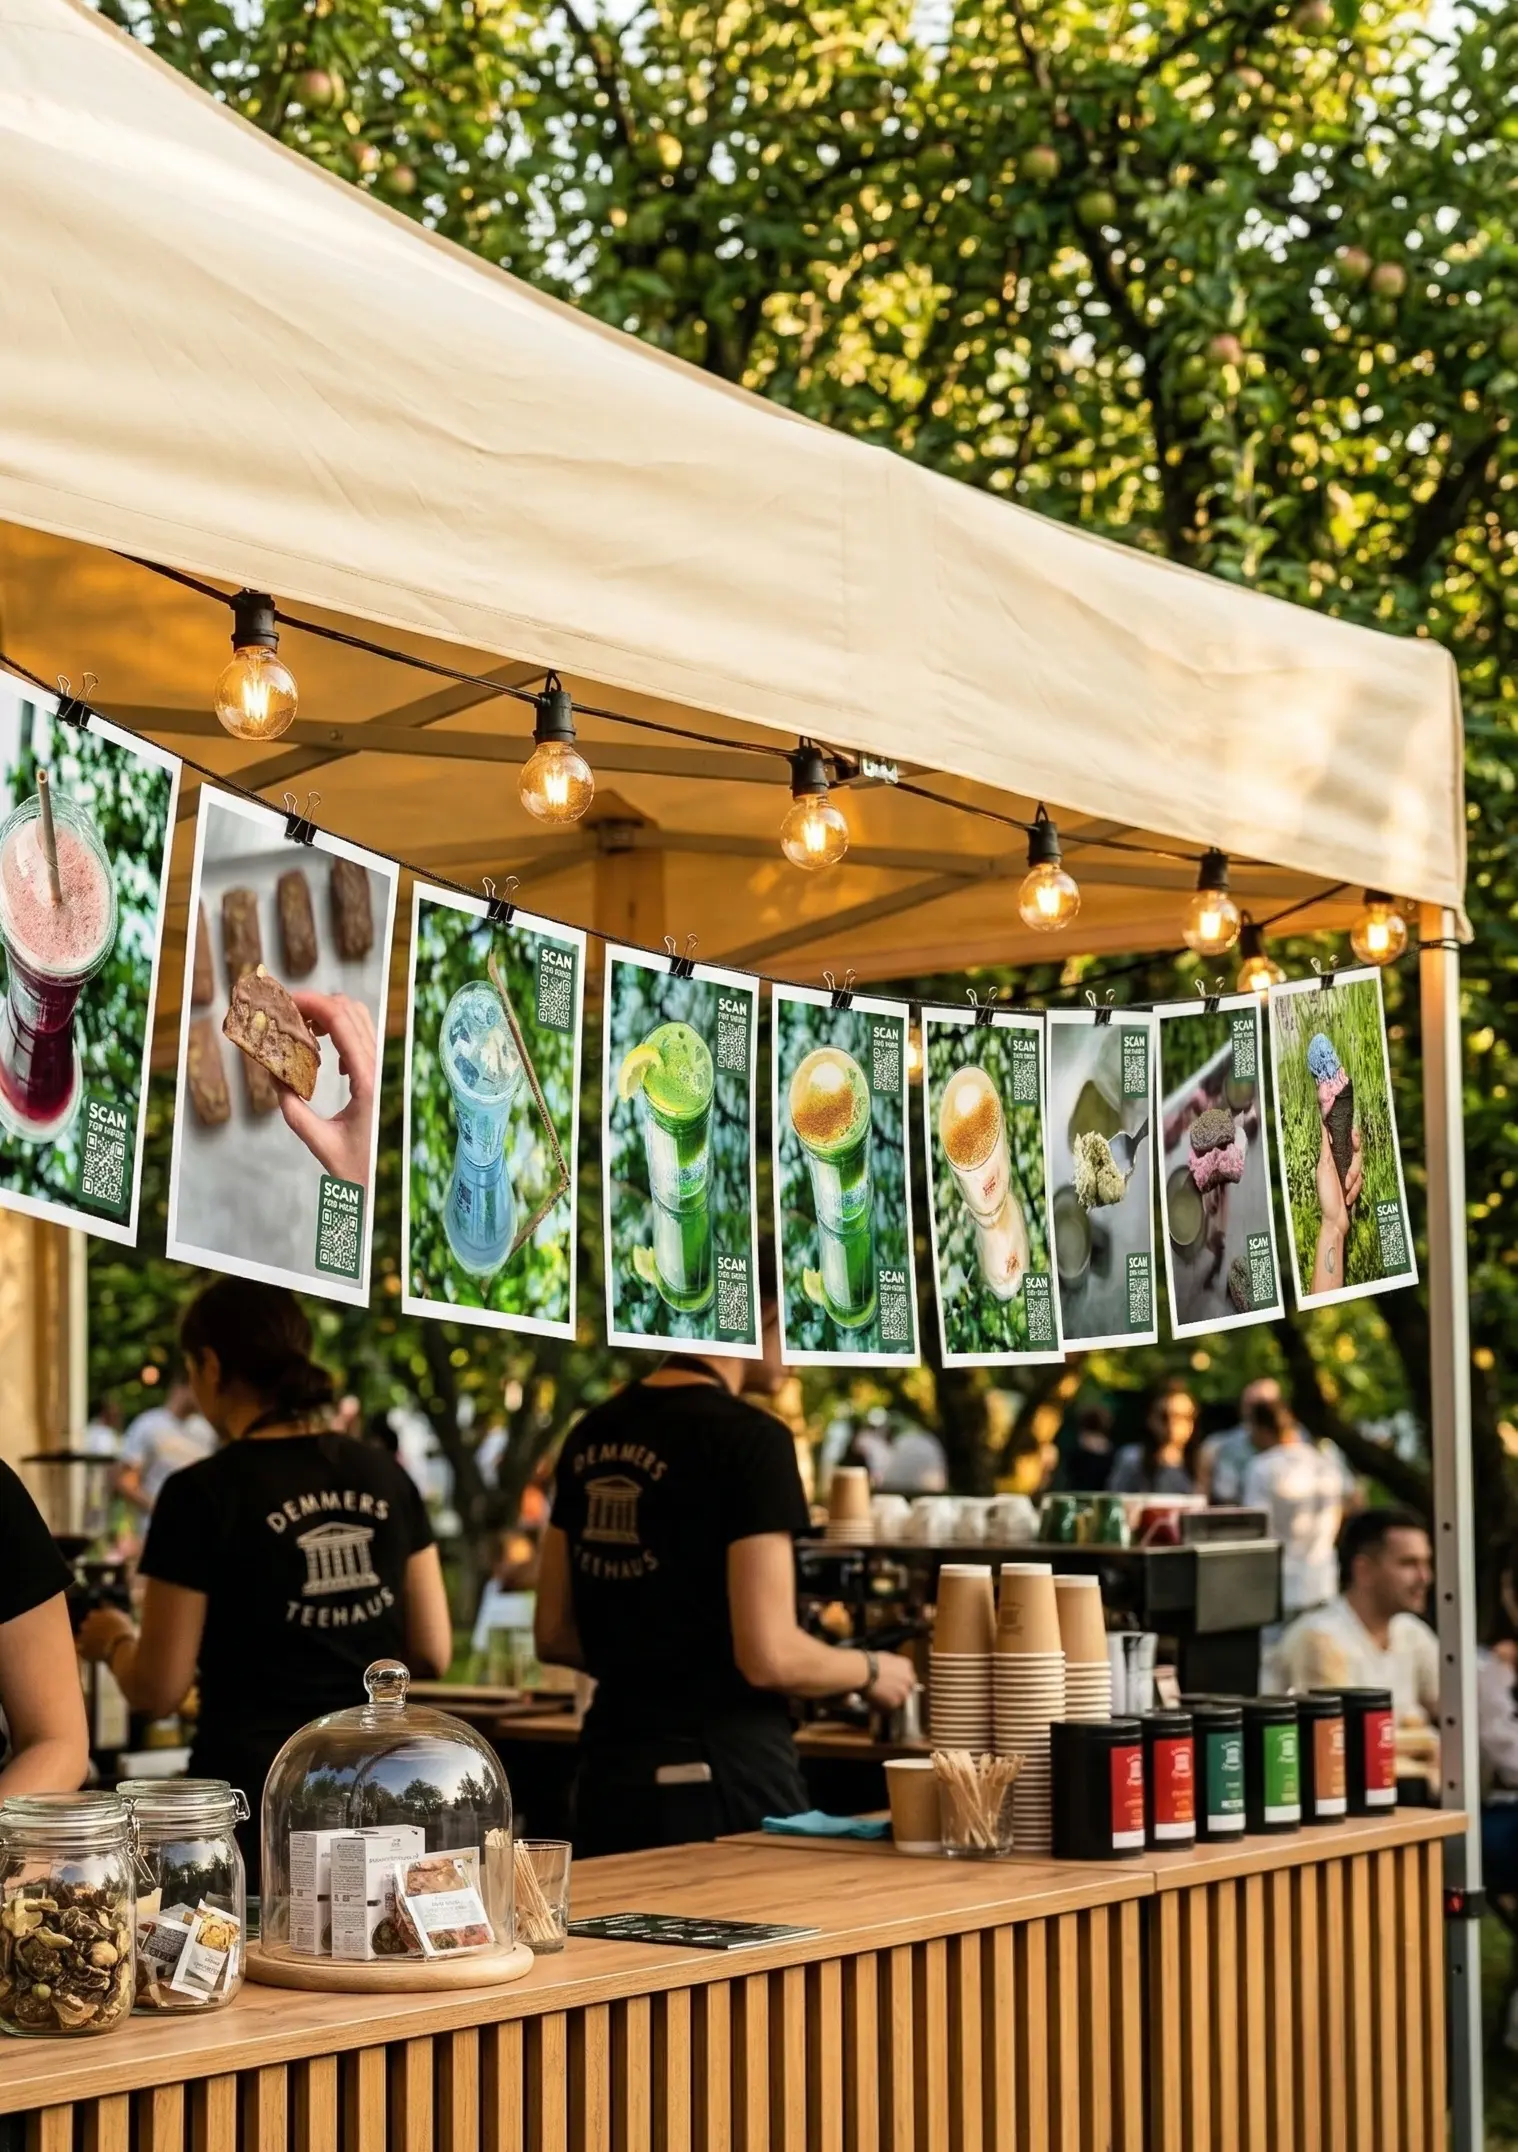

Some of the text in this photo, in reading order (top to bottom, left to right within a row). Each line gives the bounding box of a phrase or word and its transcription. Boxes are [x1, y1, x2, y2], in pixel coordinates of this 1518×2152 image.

[541, 948, 572, 970] SCAN
[718, 997, 747, 1016] SCAN
[1233, 1019, 1254, 1032] SCAN
[873, 1026, 899, 1041] SCAN
[1013, 1039, 1036, 1053] SCAN
[1124, 1036, 1145, 1048] SCAN
[89, 1102, 127, 1130] SCAN
[324, 1181, 359, 1205] SCAN
[1376, 1202, 1399, 1217] SCAN
[717, 1256, 747, 1272] SCAN
[1129, 1256, 1148, 1269] SCAN
[879, 1270, 905, 1284] SCAN
[1025, 1277, 1048, 1289] SCAN
[573, 1443, 668, 1482] DEMMERS
[265, 1489, 390, 1534] DEMMERS
[285, 1586, 396, 1628] TEEHAUS
